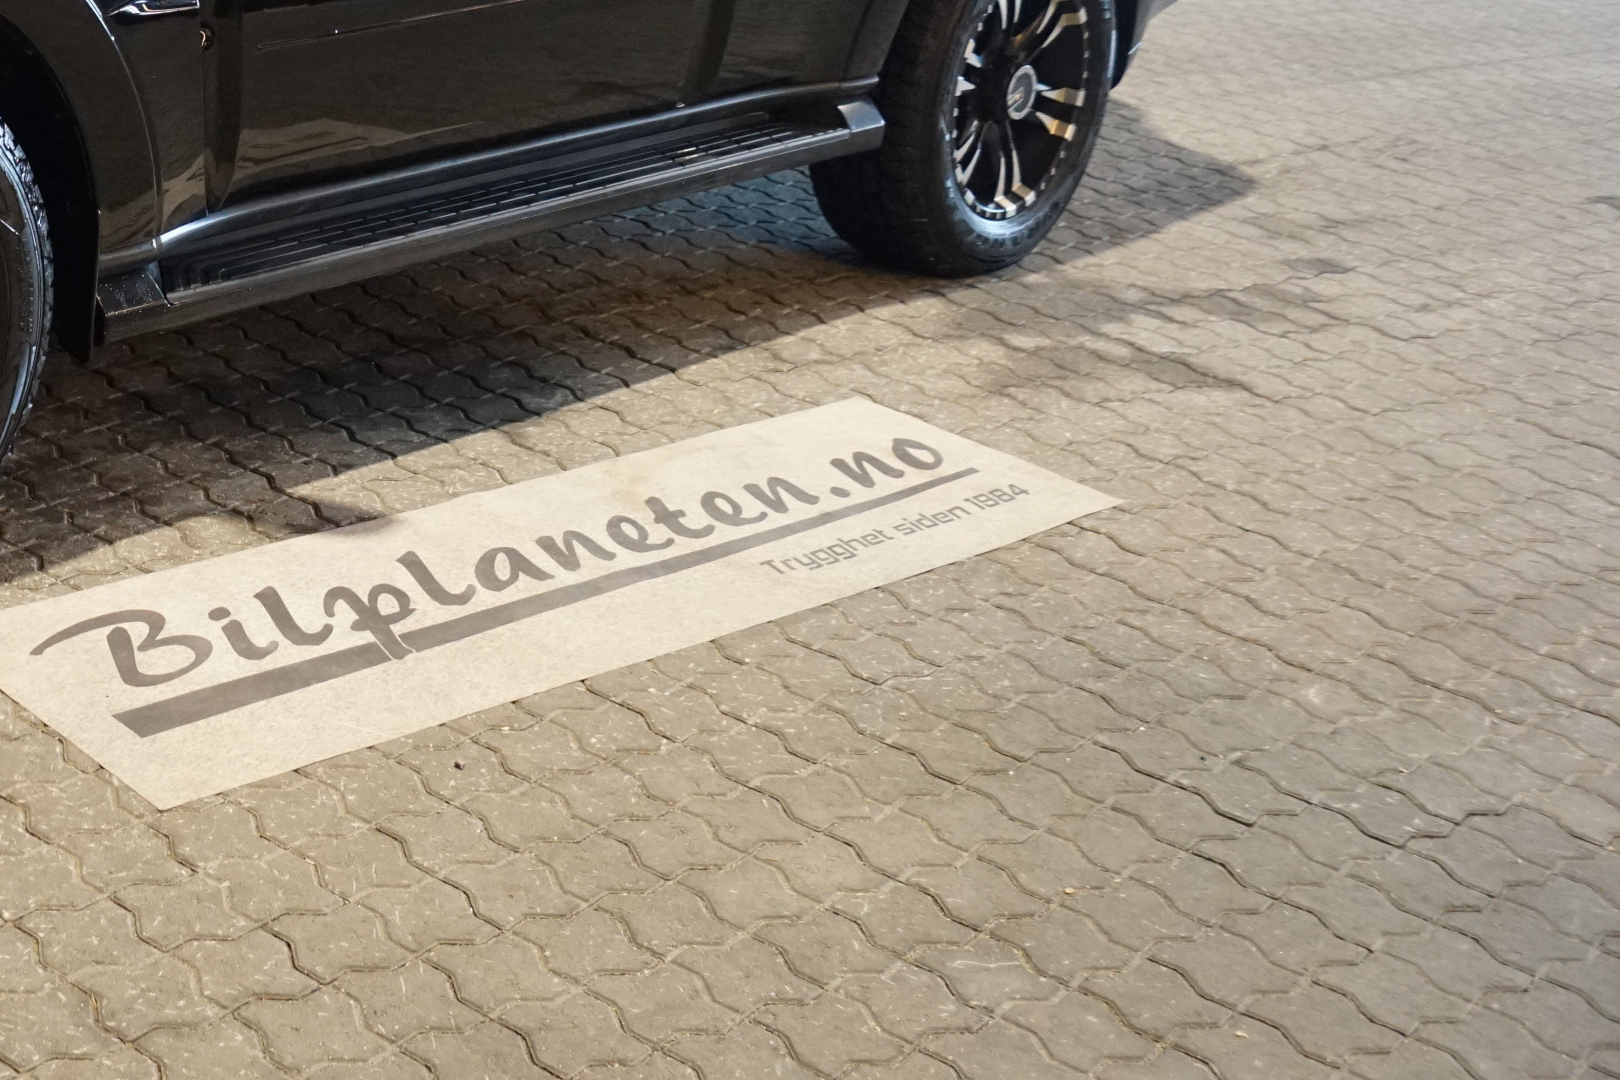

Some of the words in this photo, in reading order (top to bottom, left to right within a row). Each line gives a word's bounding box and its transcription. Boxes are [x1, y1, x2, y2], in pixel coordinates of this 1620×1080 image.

[30, 435, 946, 688] Bilplaneten.no
[759, 528, 894, 574] Trygghet
[892, 506, 972, 536] siden
[963, 483, 1031, 512] 1984
